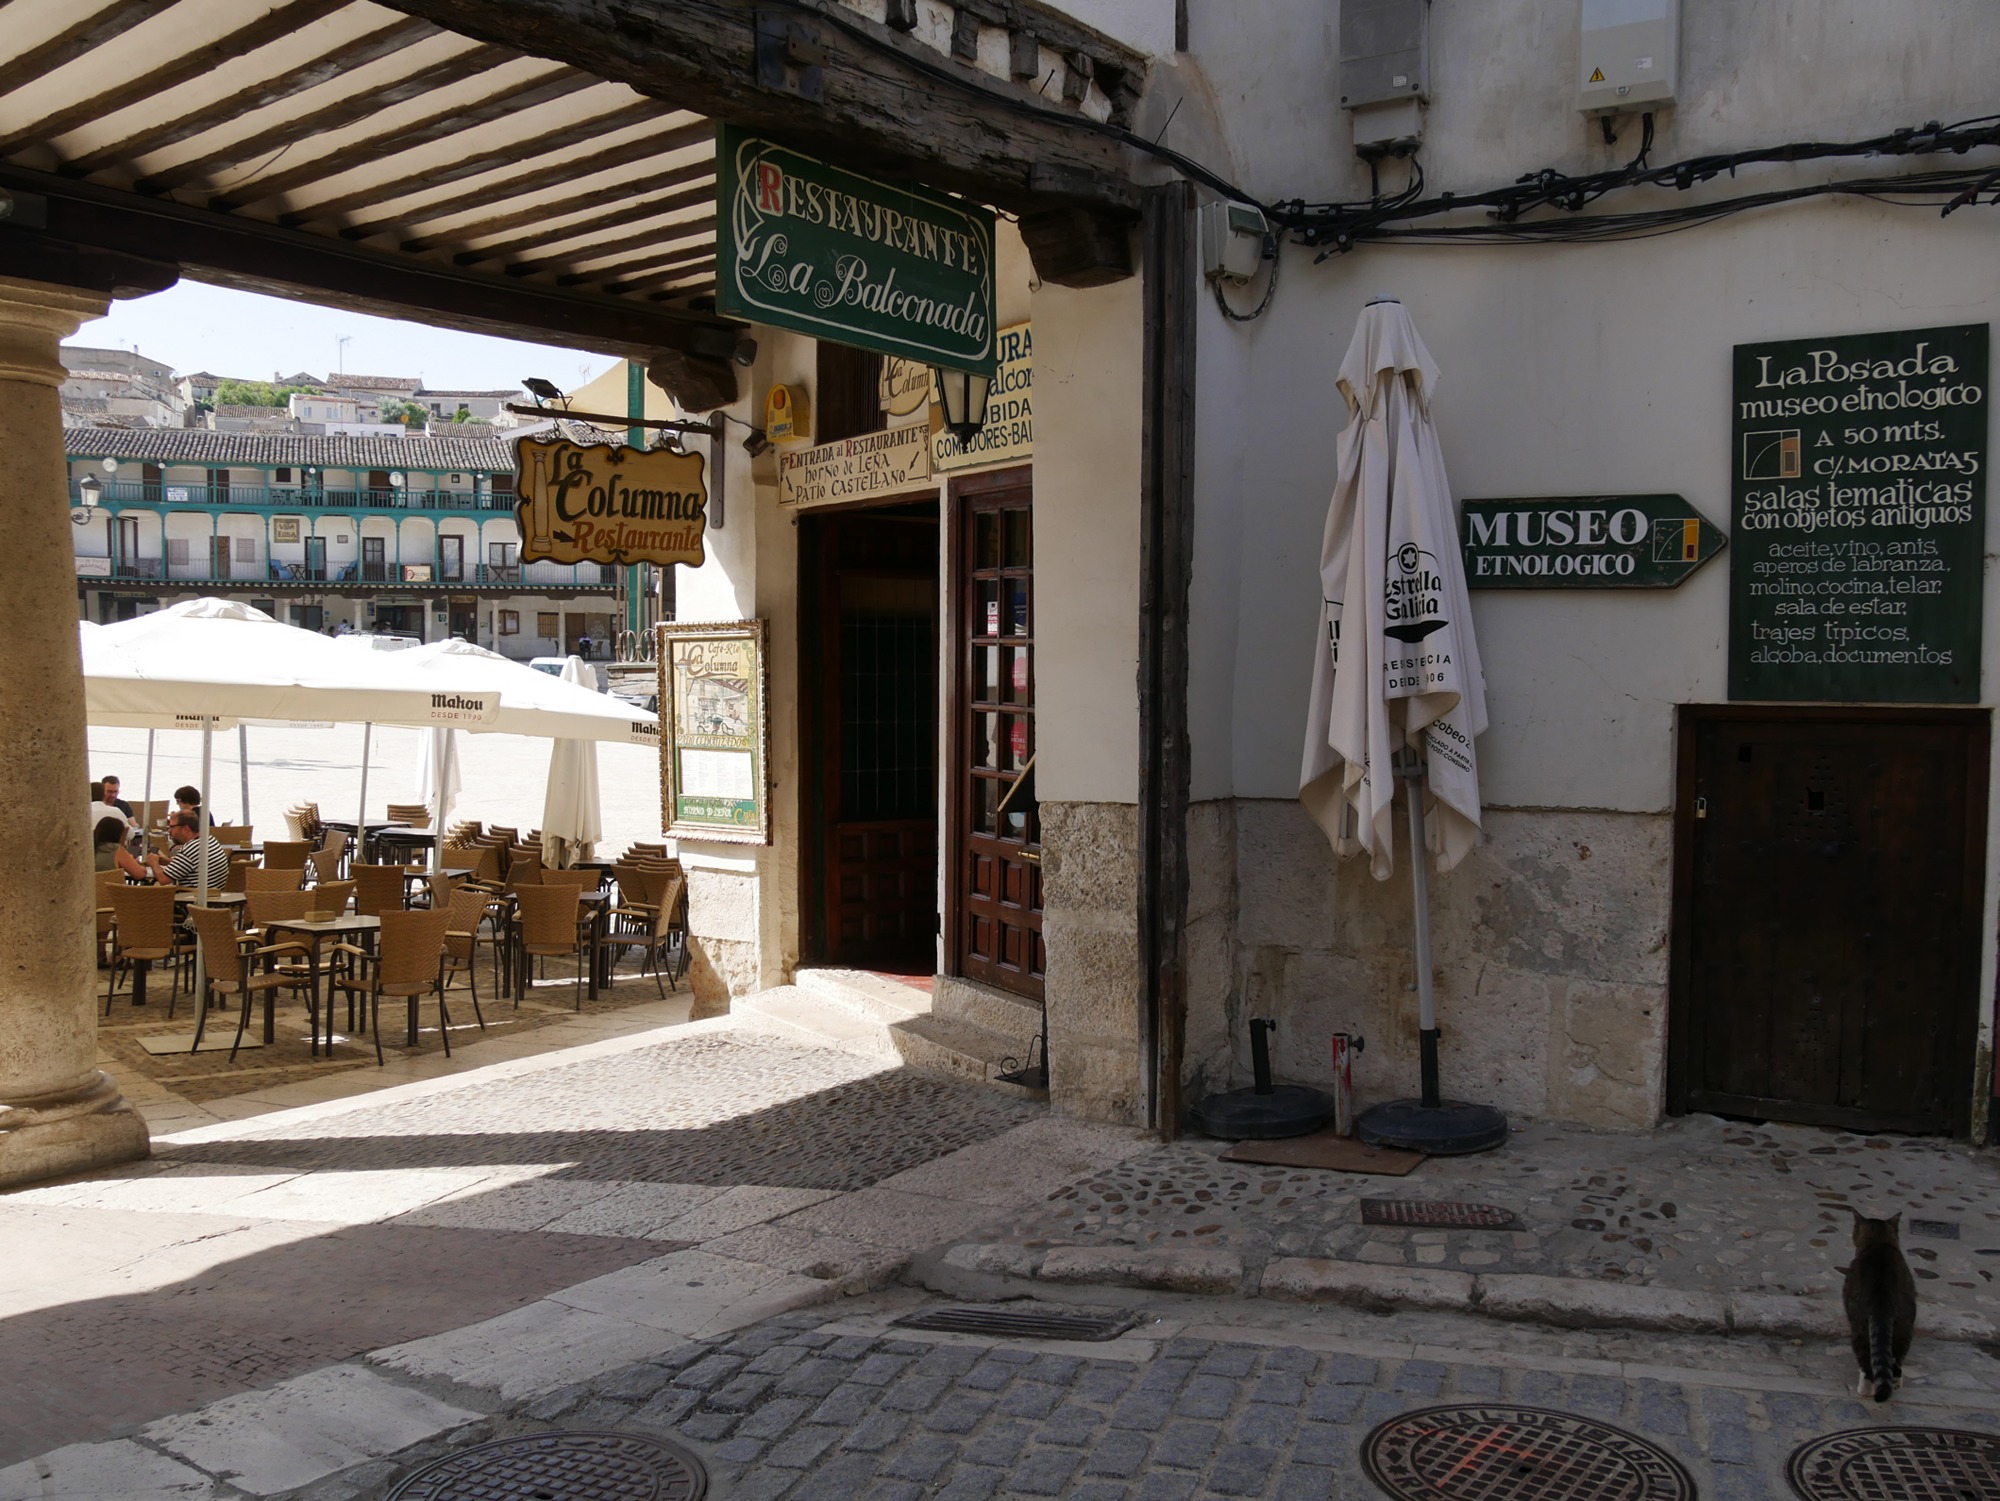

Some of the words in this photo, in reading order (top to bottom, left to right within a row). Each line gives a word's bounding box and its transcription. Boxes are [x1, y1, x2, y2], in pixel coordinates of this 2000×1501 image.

[757, 160, 978, 275] RESTAURANTE
[740, 234, 814, 294] La
[814, 254, 986, 342] Balconada
[1740, 395, 1839, 419] museo
[1841, 377, 1982, 412] etnologico
[789, 446, 835, 469] ENTRADA
[846, 427, 918, 458] RESTAURANTE
[1814, 429, 1834, 447] A
[1844, 427, 1878, 444] 50
[1883, 420, 1946, 443] mts.
[548, 444, 584, 486] La
[556, 470, 702, 522] Columna
[1745, 485, 1820, 513] salas
[1827, 478, 1973, 507] tematicas
[1465, 508, 1649, 547] MUSEO
[1741, 511, 1780, 530] con
[1783, 508, 1866, 533] objetos
[1871, 504, 1972, 529] antiguos
[571, 521, 701, 554] Restaurante
[1475, 553, 1636, 576] ETNOLOGICO
[1753, 559, 1819, 577] aperos
[1821, 557, 1846, 571] de
[1851, 556, 1951, 572] labranza,
[1774, 598, 1819, 615] sala
[1820, 597, 1845, 614] de
[1750, 619, 1817, 645] trajes
[431, 693, 484, 711] Mahou
[431, 711, 459, 719] DESDE
[1396, 1410, 1504, 1438] CANAL
[1517, 1412, 1566, 1430] DE
